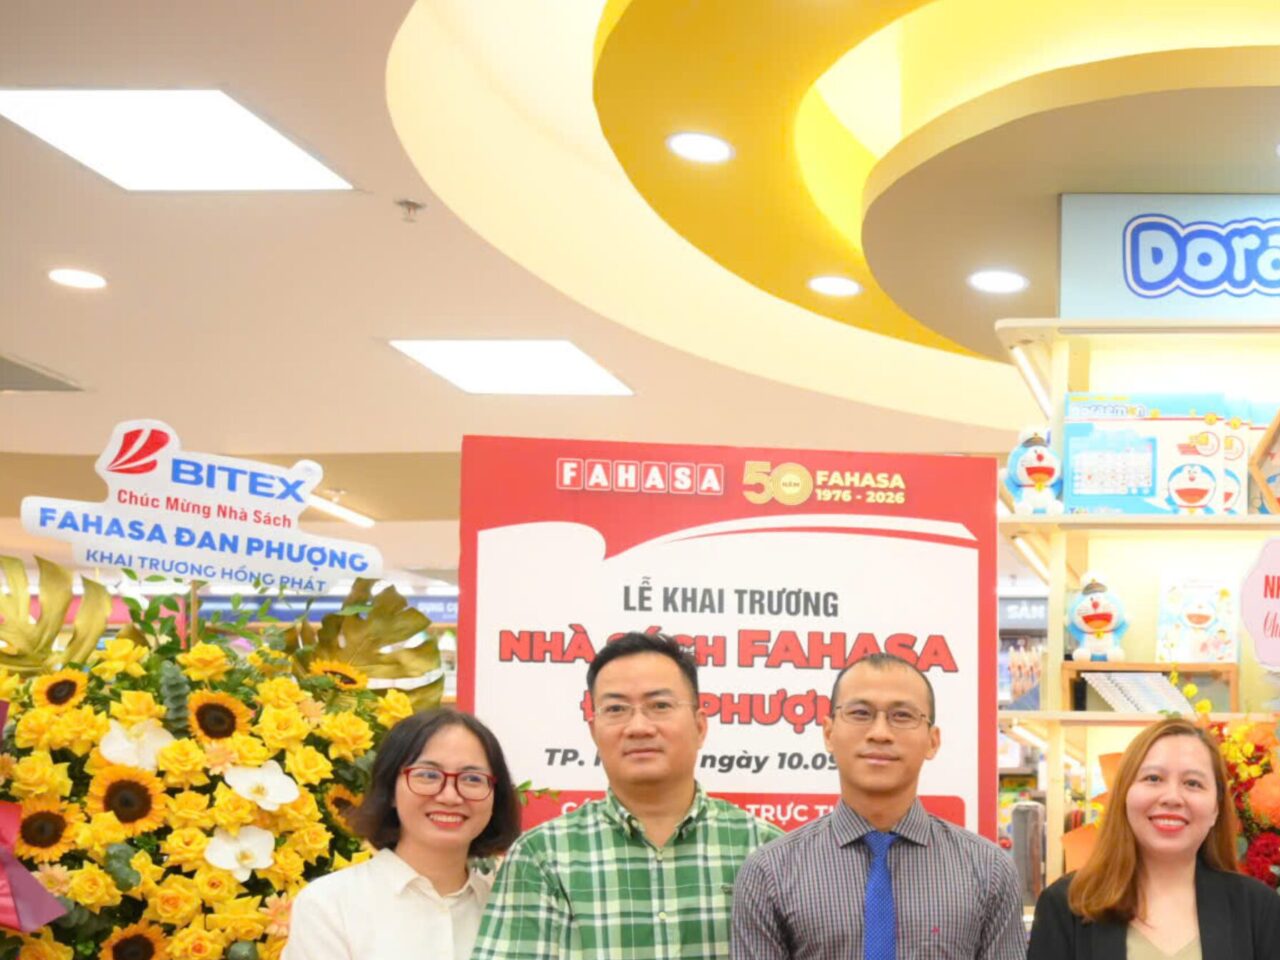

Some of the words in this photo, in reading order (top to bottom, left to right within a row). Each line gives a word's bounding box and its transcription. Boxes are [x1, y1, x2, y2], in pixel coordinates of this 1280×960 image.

[170, 458, 306, 503] BITEX
[562, 461, 721, 492] FAHASA
[742, 460, 814, 506] 50
[815, 470, 906, 489] FAHASA
[815, 488, 852, 502] 1976
[866, 491, 905, 504] 2026
[117, 488, 161, 509] Chúc
[165, 493, 212, 519] Mừng
[216, 502, 249, 522] Nhà
[253, 507, 293, 528] Sách
[38, 506, 168, 545] FAHASA
[174, 525, 240, 554] ĐAN
[245, 536, 370, 573] PHƯỢNG
[85, 549, 134, 568] KHAI
[279, 572, 328, 594] PHÁT
[623, 576, 653, 612] LỄ
[662, 586, 725, 614] KHAI
[734, 587, 839, 618] TRƯƠNG
[499, 623, 598, 664] NHÀ
[737, 629, 959, 673] FAHASA
[545, 748, 585, 767] TP.
[699, 750, 770, 774] ngày
